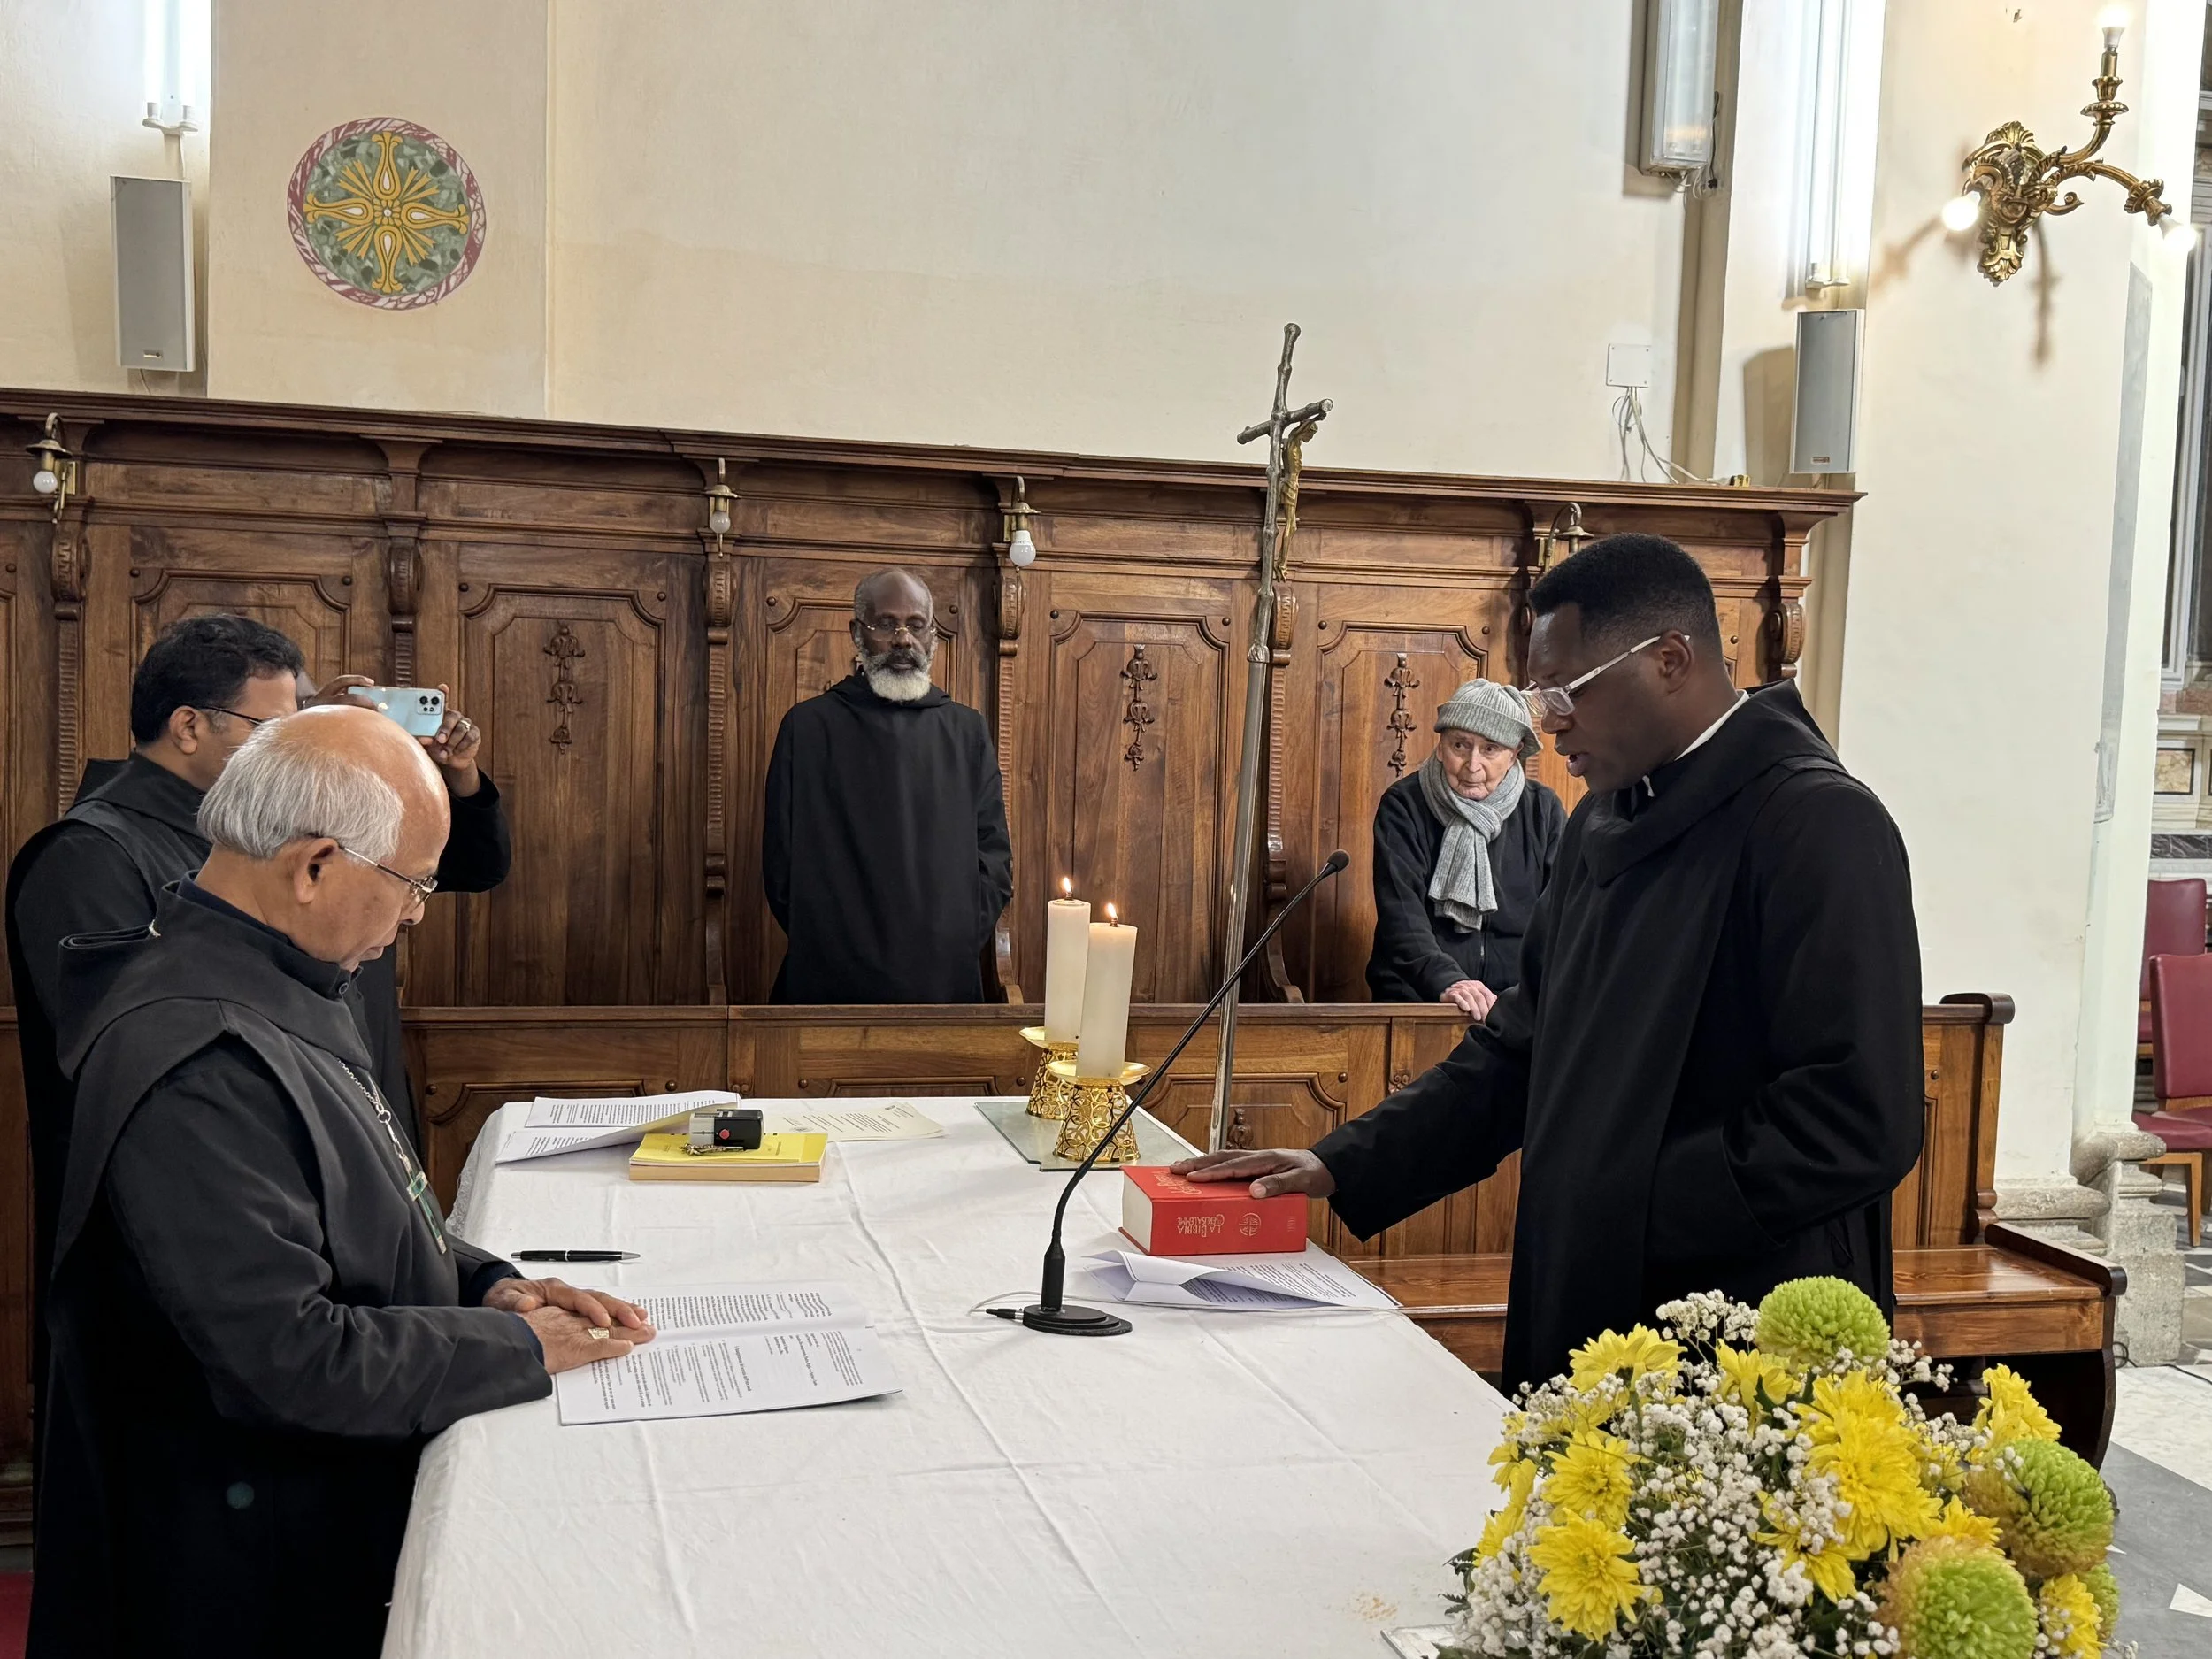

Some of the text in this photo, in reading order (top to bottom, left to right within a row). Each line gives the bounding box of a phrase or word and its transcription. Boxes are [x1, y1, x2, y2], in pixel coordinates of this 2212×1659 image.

[1177, 1214, 1225, 1226] GERUSALEMME
[1178, 1225, 1221, 1237] LA BIBBIA
